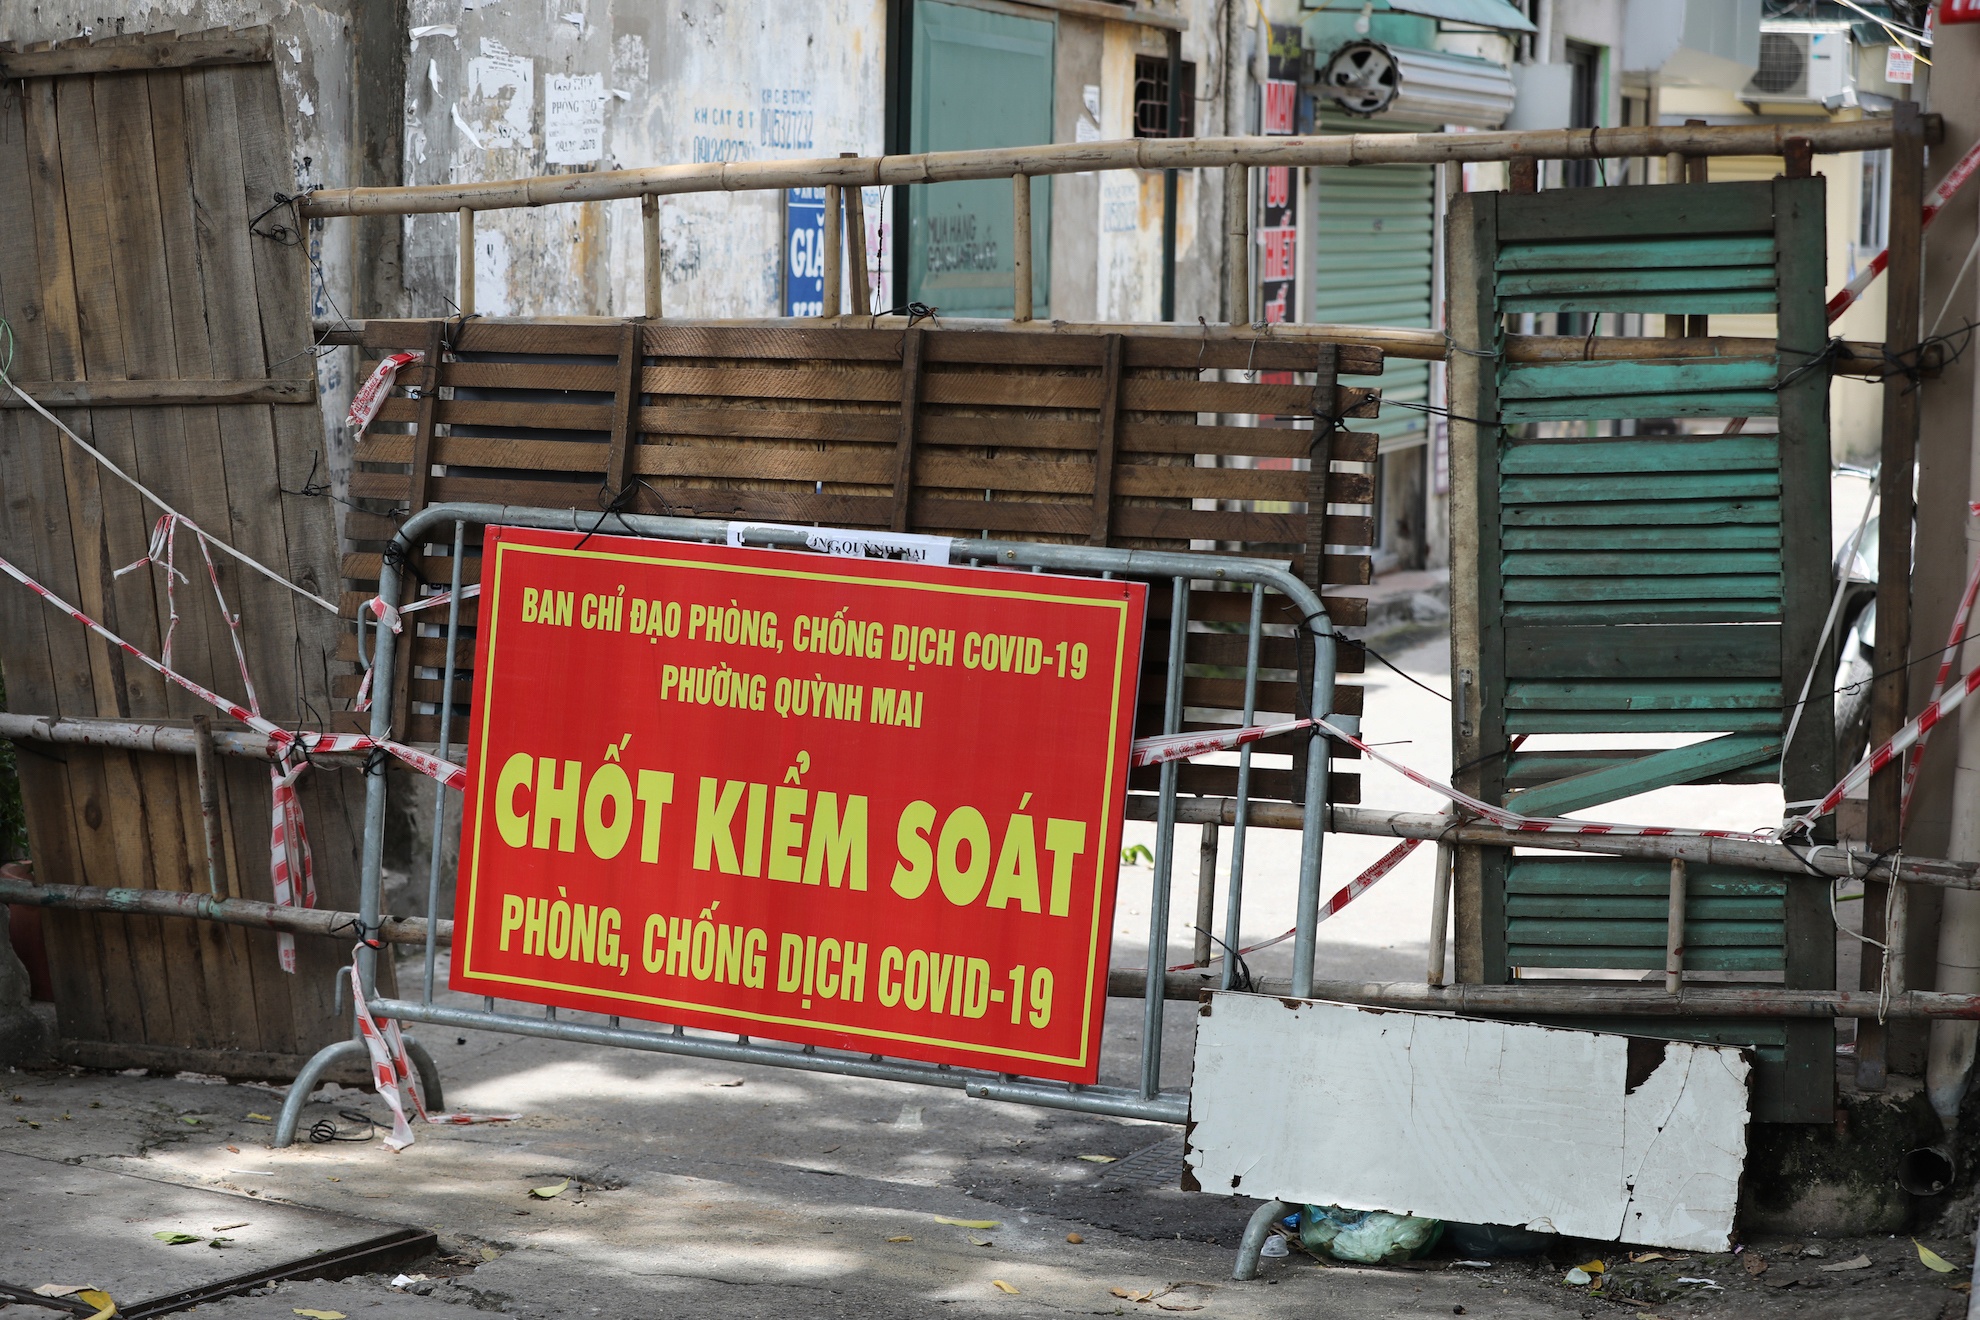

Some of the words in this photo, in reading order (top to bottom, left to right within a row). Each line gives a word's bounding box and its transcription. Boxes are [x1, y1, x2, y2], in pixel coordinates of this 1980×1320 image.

[522, 588, 574, 626] BAN
[581, 584, 625, 631] CHỈ
[629, 599, 682, 645] ĐẠO
[689, 599, 783, 654] PHÒNG,
[793, 606, 884, 659] CHỐNG
[891, 624, 956, 671] DỊCH
[963, 631, 1089, 680] COVID-19
[661, 663, 767, 711] PHƯỜNG
[774, 676, 864, 722] QUỲNH
[870, 687, 924, 729] MAI
[495, 734, 675, 864] CHỐT
[693, 750, 868, 892] KIỂM
[890, 792, 1087, 917] SOÁT
[500, 887, 630, 977] PHÒNG,
[642, 901, 768, 989] CHỐNG
[777, 933, 868, 1010] DỊCH
[878, 946, 1054, 1029] COVID-19
